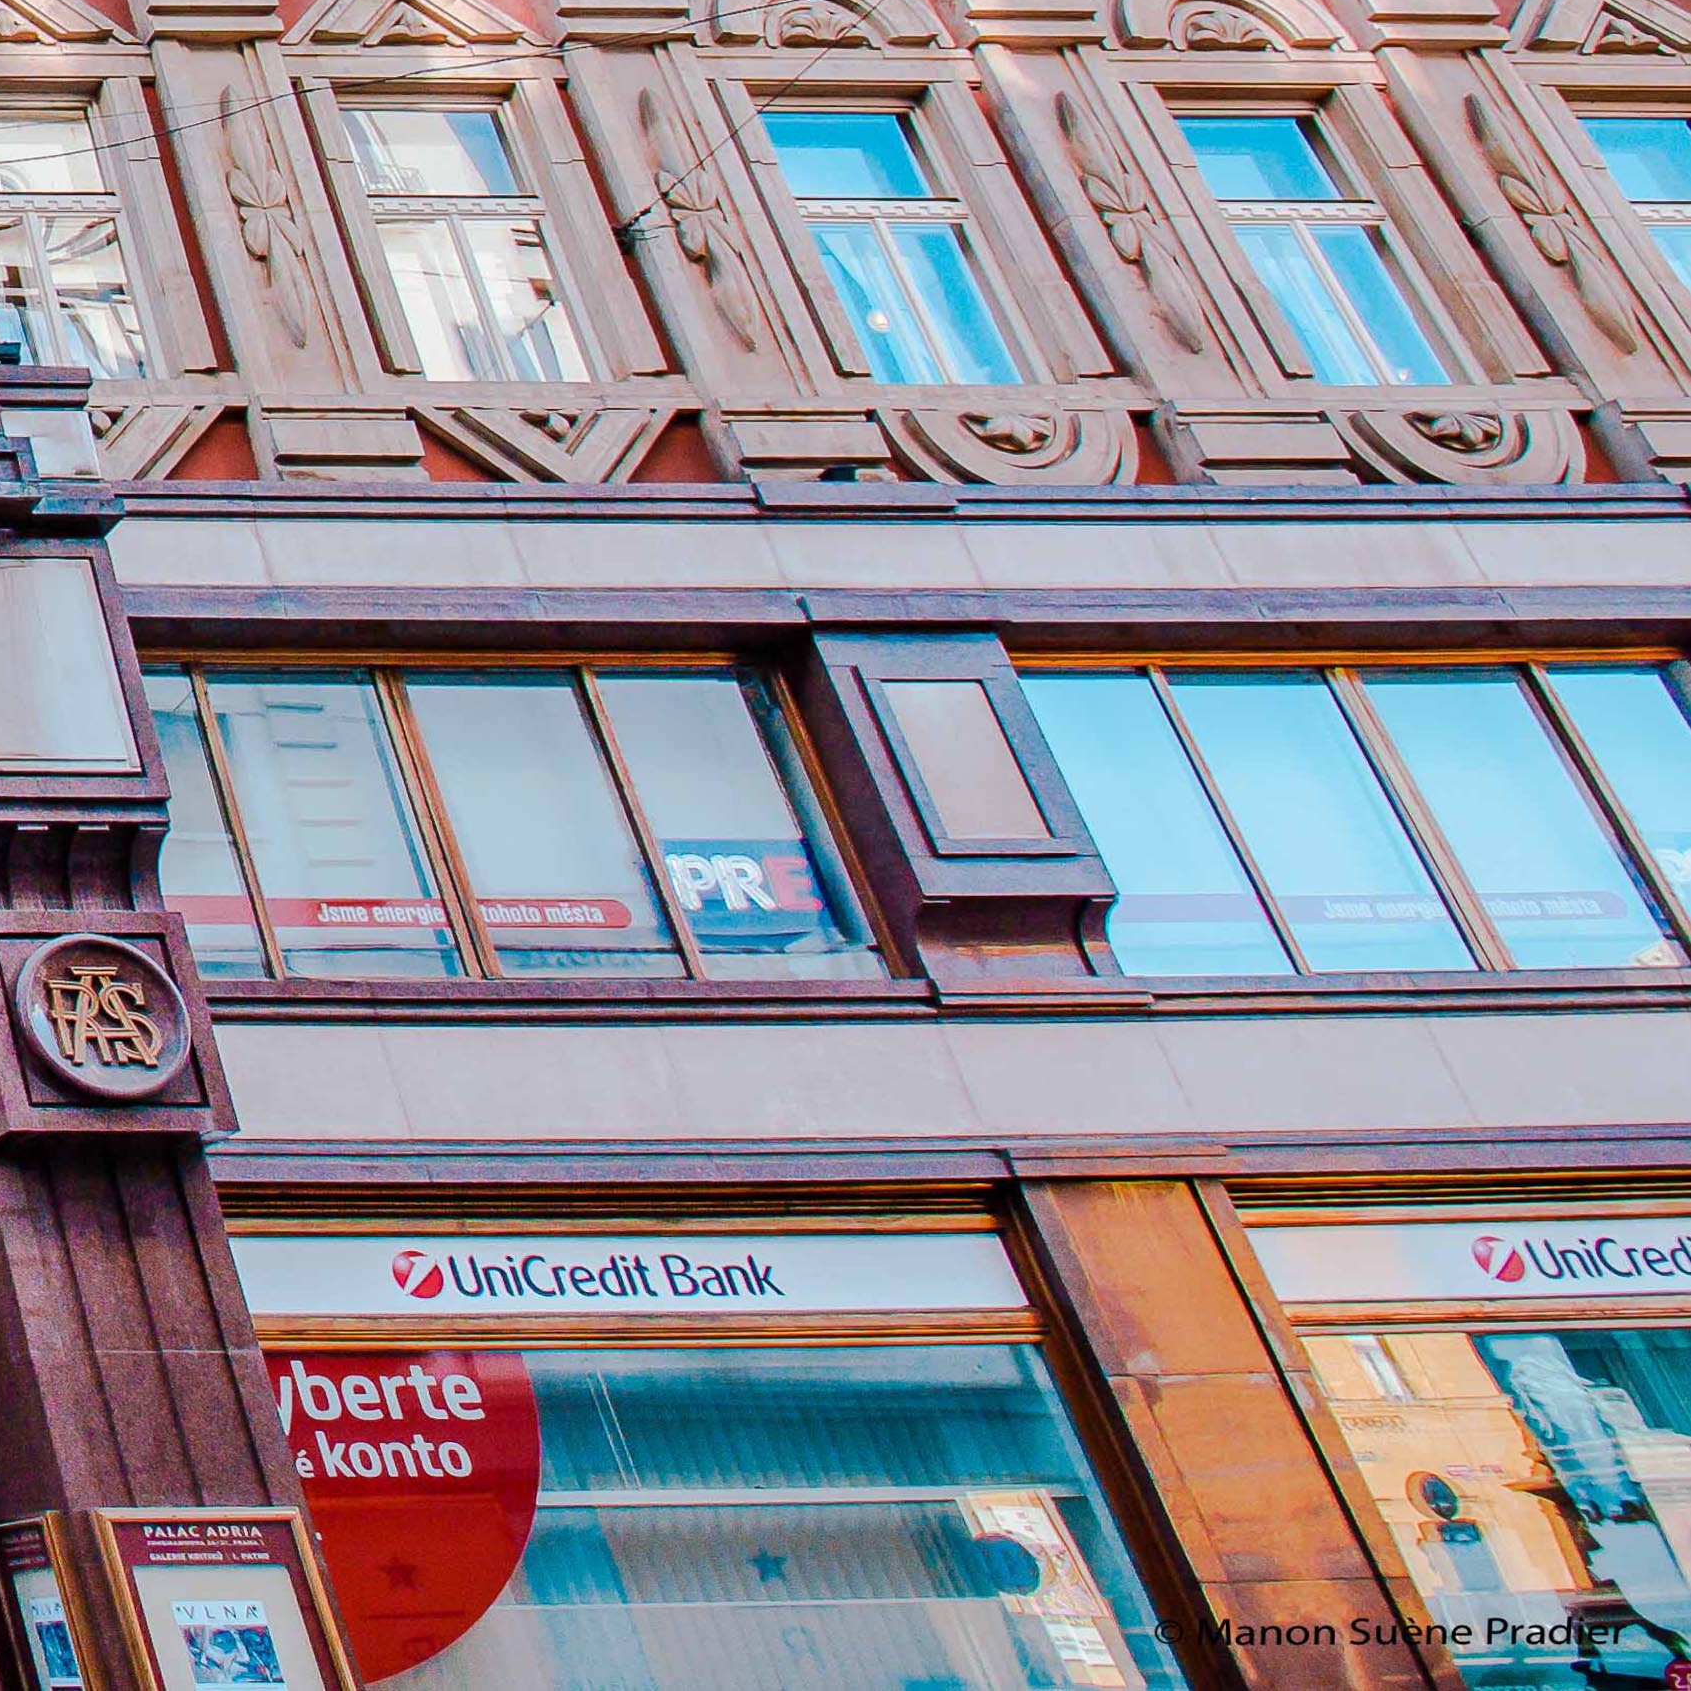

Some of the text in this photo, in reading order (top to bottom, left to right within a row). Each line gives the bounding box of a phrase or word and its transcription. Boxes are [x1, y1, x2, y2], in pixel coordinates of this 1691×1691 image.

[664, 853, 823, 911] PRE
[318, 901, 369, 923] Jsme
[479, 903, 541, 923] tohoto
[545, 902, 606, 924] města
[447, 1254, 786, 1297] UniCredit Bank
[1523, 1236, 1691, 1280] UniCred
[315, 1430, 473, 1478] konto
[206, 1524, 263, 1538] ADRIA
